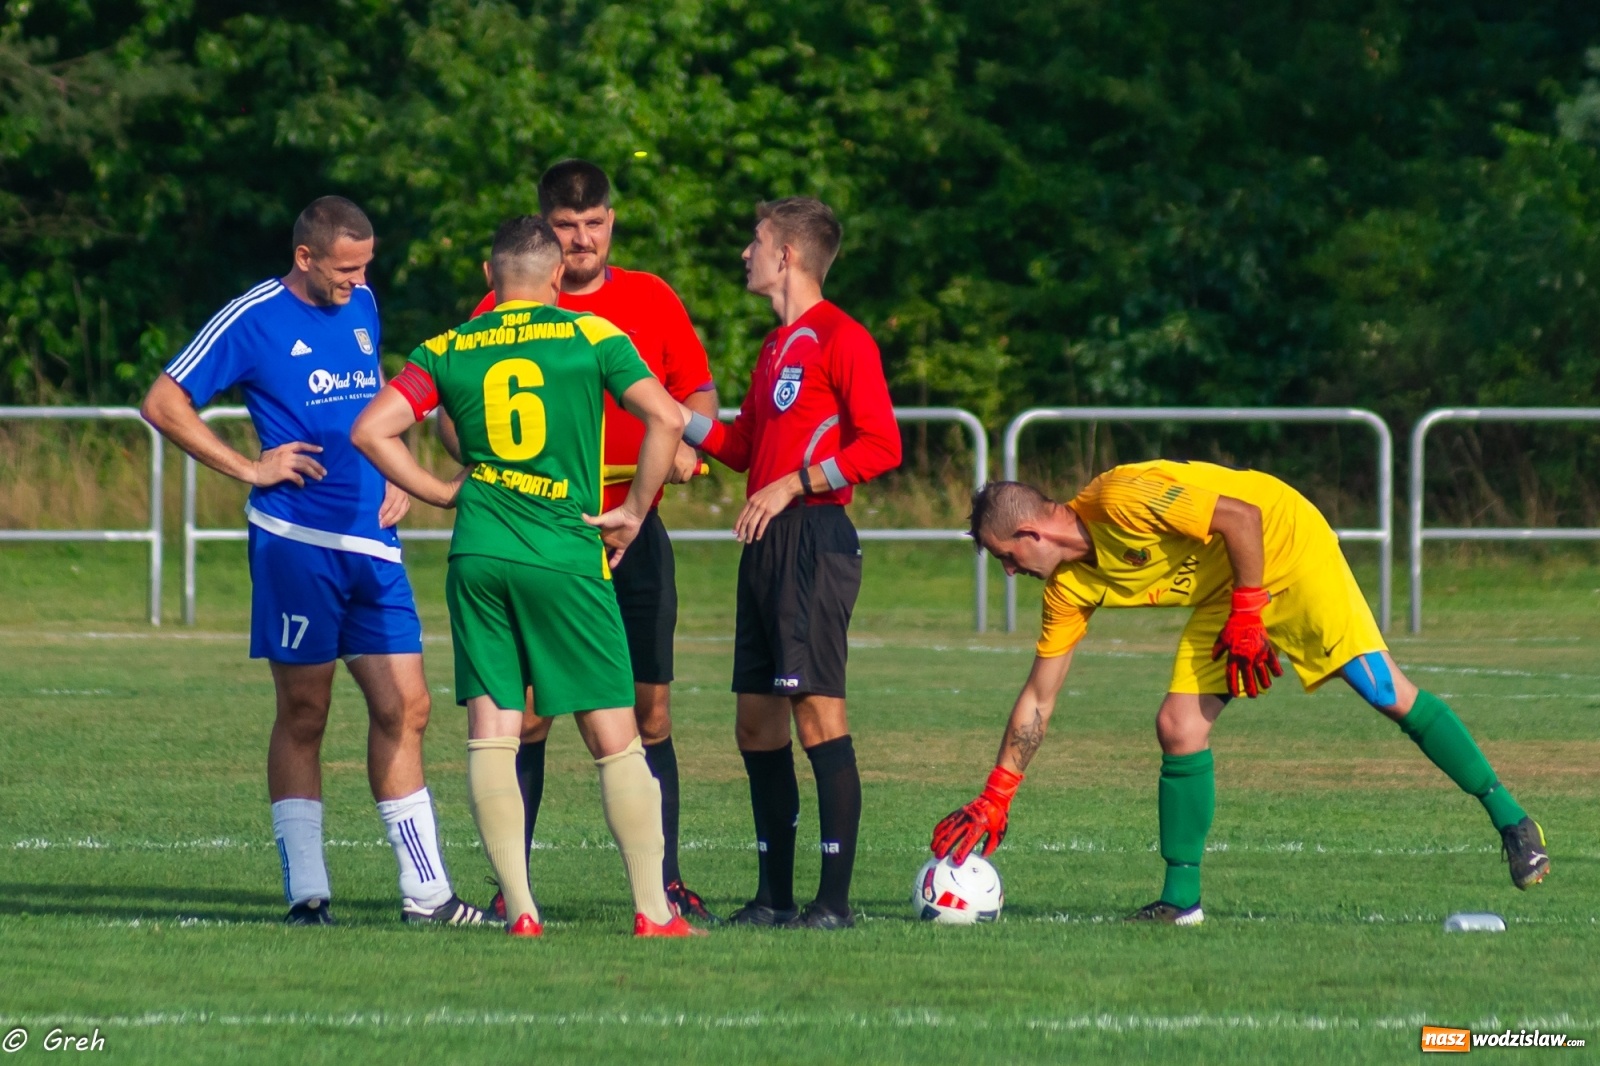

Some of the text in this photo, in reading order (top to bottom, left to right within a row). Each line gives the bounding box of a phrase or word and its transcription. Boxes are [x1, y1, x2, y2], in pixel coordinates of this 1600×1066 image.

[501, 312, 531, 327] 1946
[517, 322, 575, 343] ZAWADA
[483, 357, 546, 461] 6
[281, 612, 310, 649] 17
